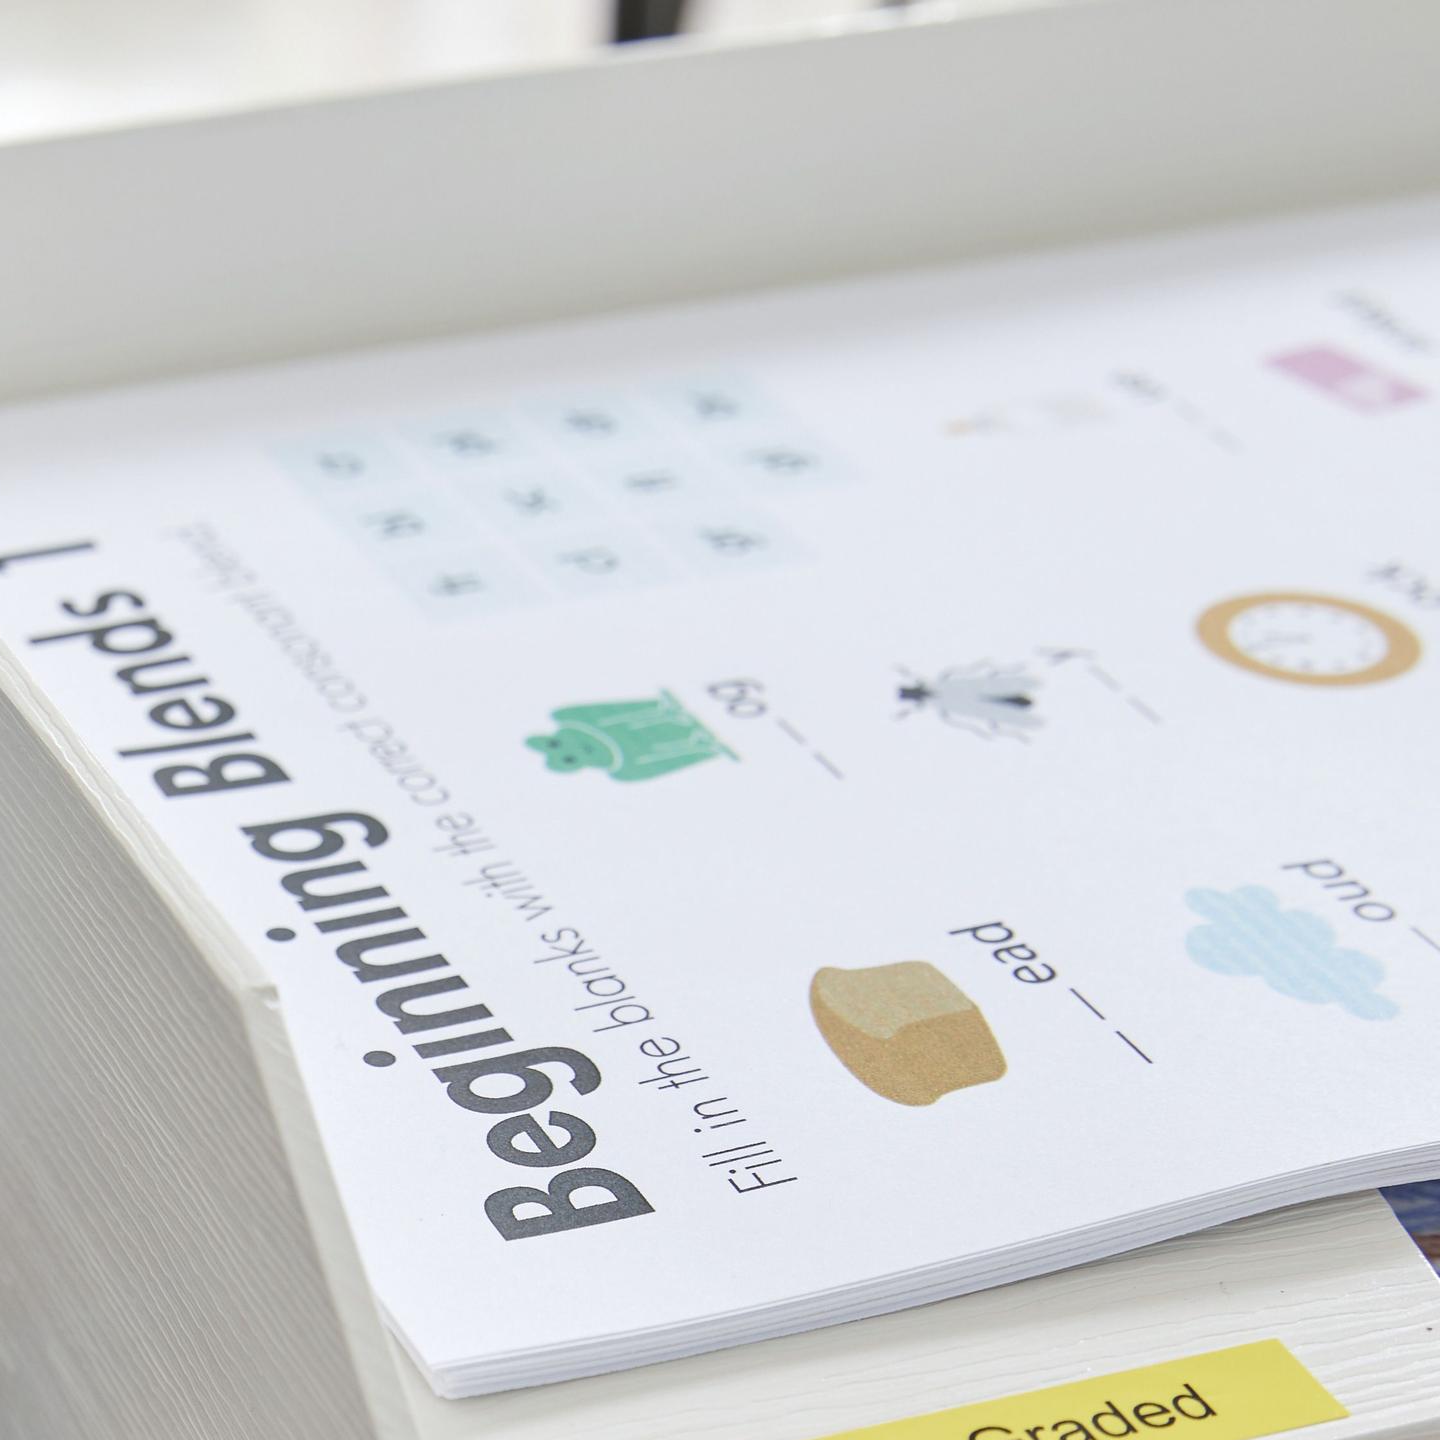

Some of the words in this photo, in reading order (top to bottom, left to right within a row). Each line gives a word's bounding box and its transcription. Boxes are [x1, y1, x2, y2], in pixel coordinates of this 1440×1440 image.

[28, 588, 292, 797] Blends
[706, 676, 767, 720] og
[337, 717, 450, 807] correct
[431, 811, 497, 857] the
[462, 860, 553, 922] with
[1282, 857, 1397, 925] oud
[533, 927, 655, 1033] blanks
[948, 920, 1057, 986] ead
[239, 811, 656, 1241] Beginning
[638, 1037, 710, 1090] the
[693, 1097, 747, 1134] in
[702, 1141, 798, 1194] Fill
